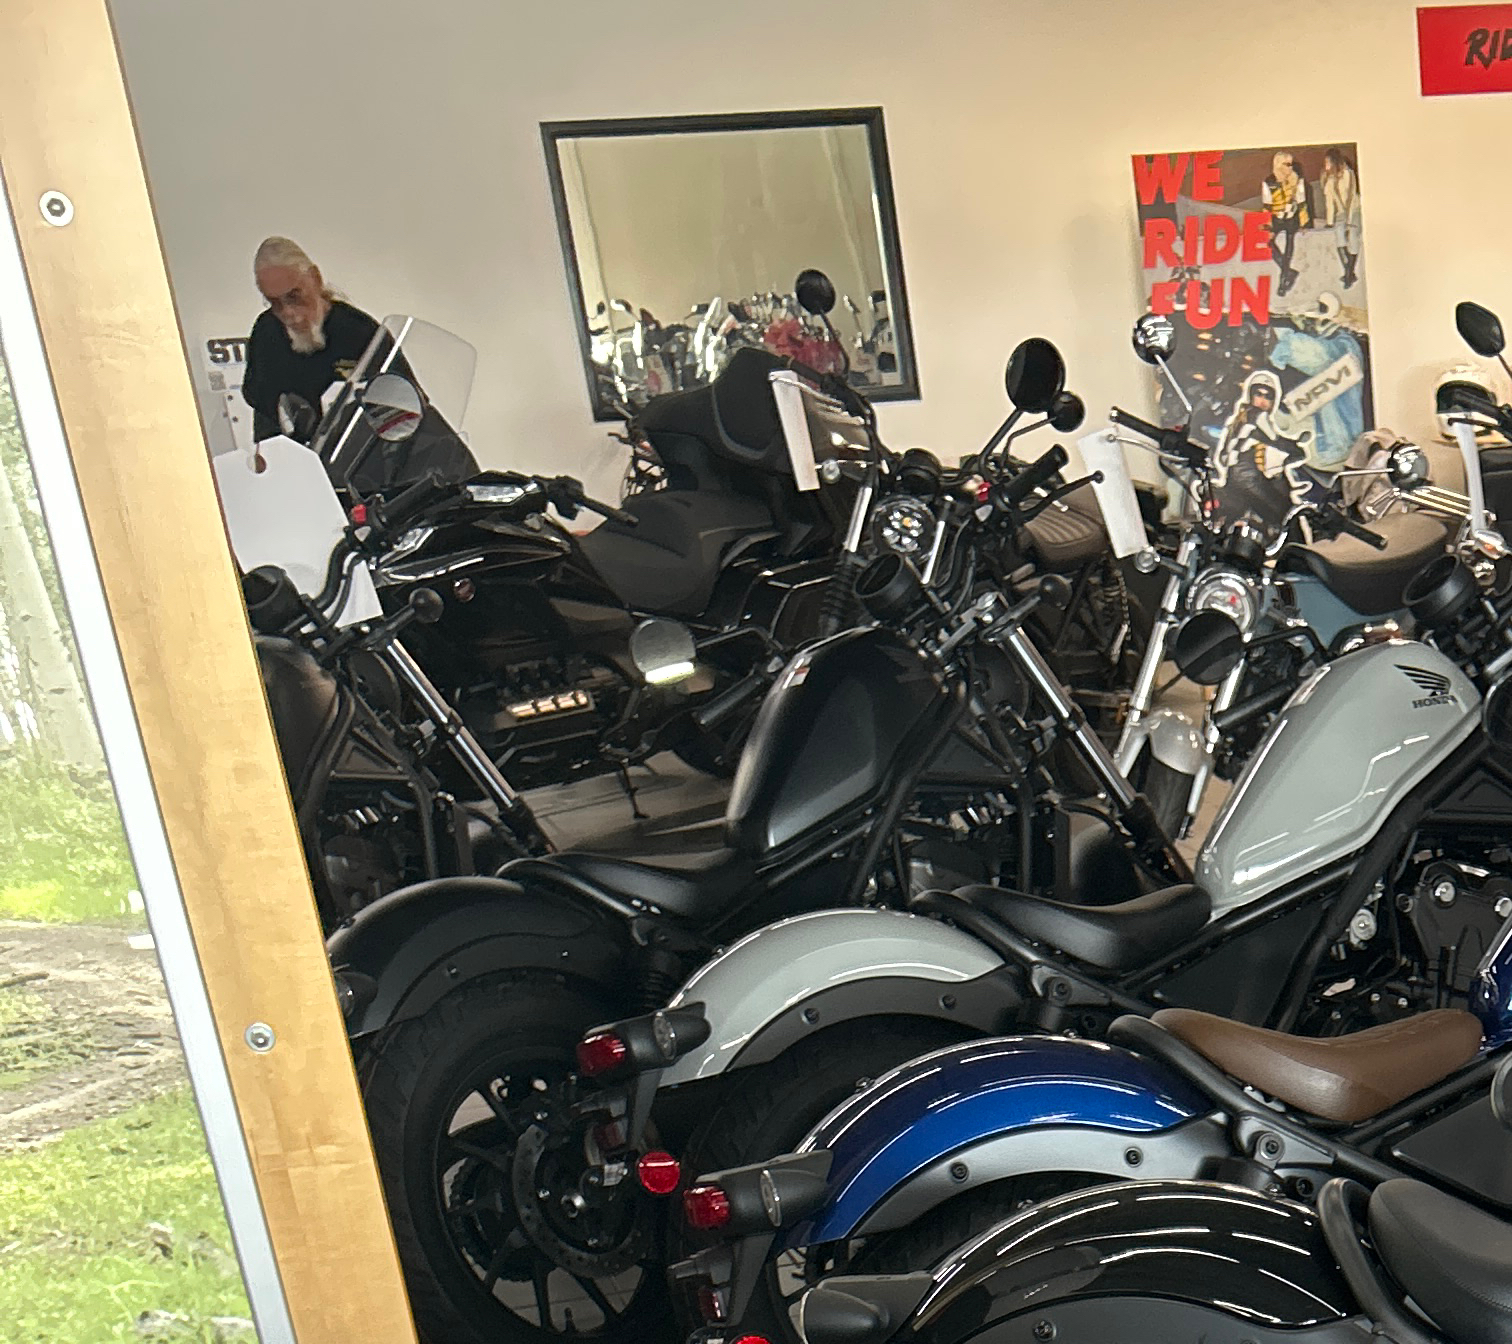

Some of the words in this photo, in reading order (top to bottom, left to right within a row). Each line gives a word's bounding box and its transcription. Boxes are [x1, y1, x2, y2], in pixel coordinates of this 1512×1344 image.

[1133, 151, 1224, 205] WE
[1143, 211, 1273, 269] RIDE
[1151, 276, 1271, 330] FUN
